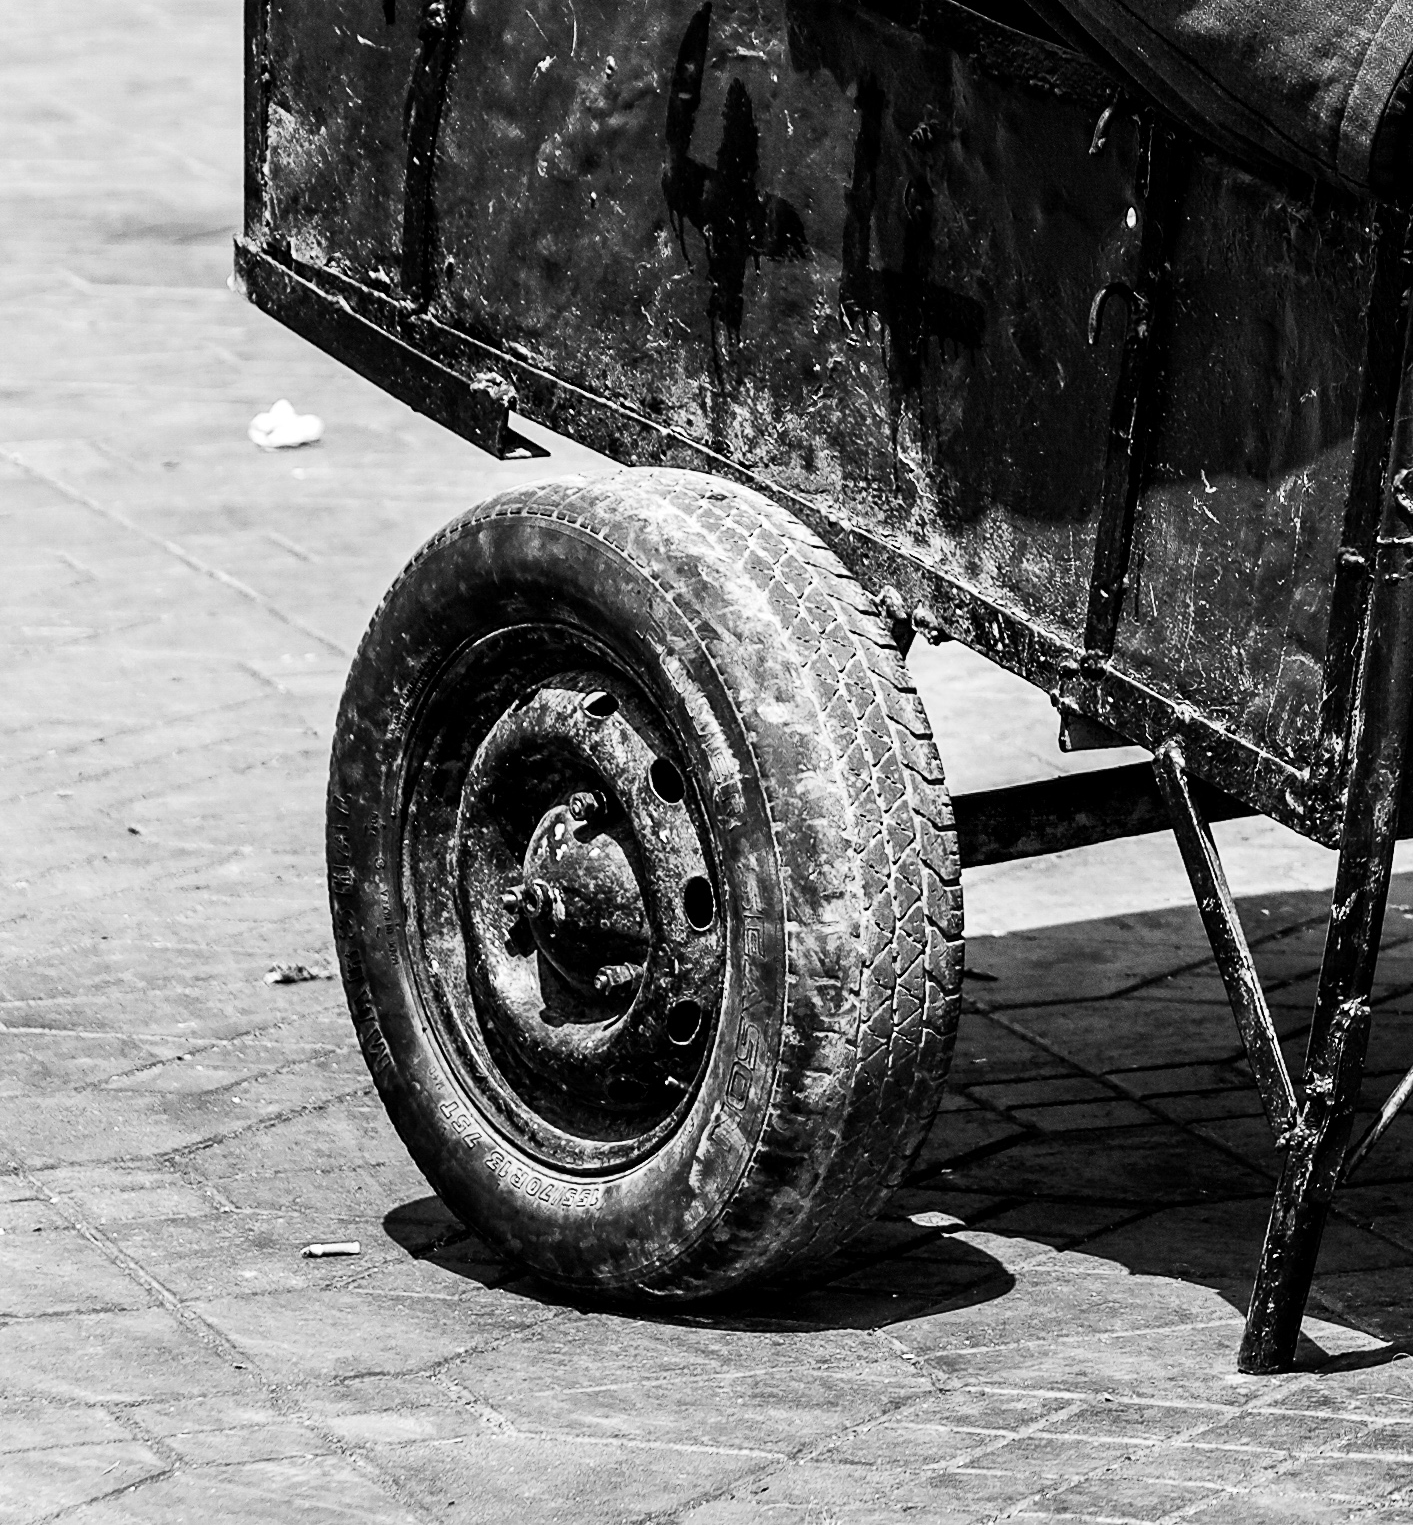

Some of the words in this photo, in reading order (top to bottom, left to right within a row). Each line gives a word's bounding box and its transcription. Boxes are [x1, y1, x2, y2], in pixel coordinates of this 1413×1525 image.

[711, 863, 766, 1153] SEASON
[439, 1100, 483, 1150] 75T
[484, 1150, 602, 1210] 155/70R13
